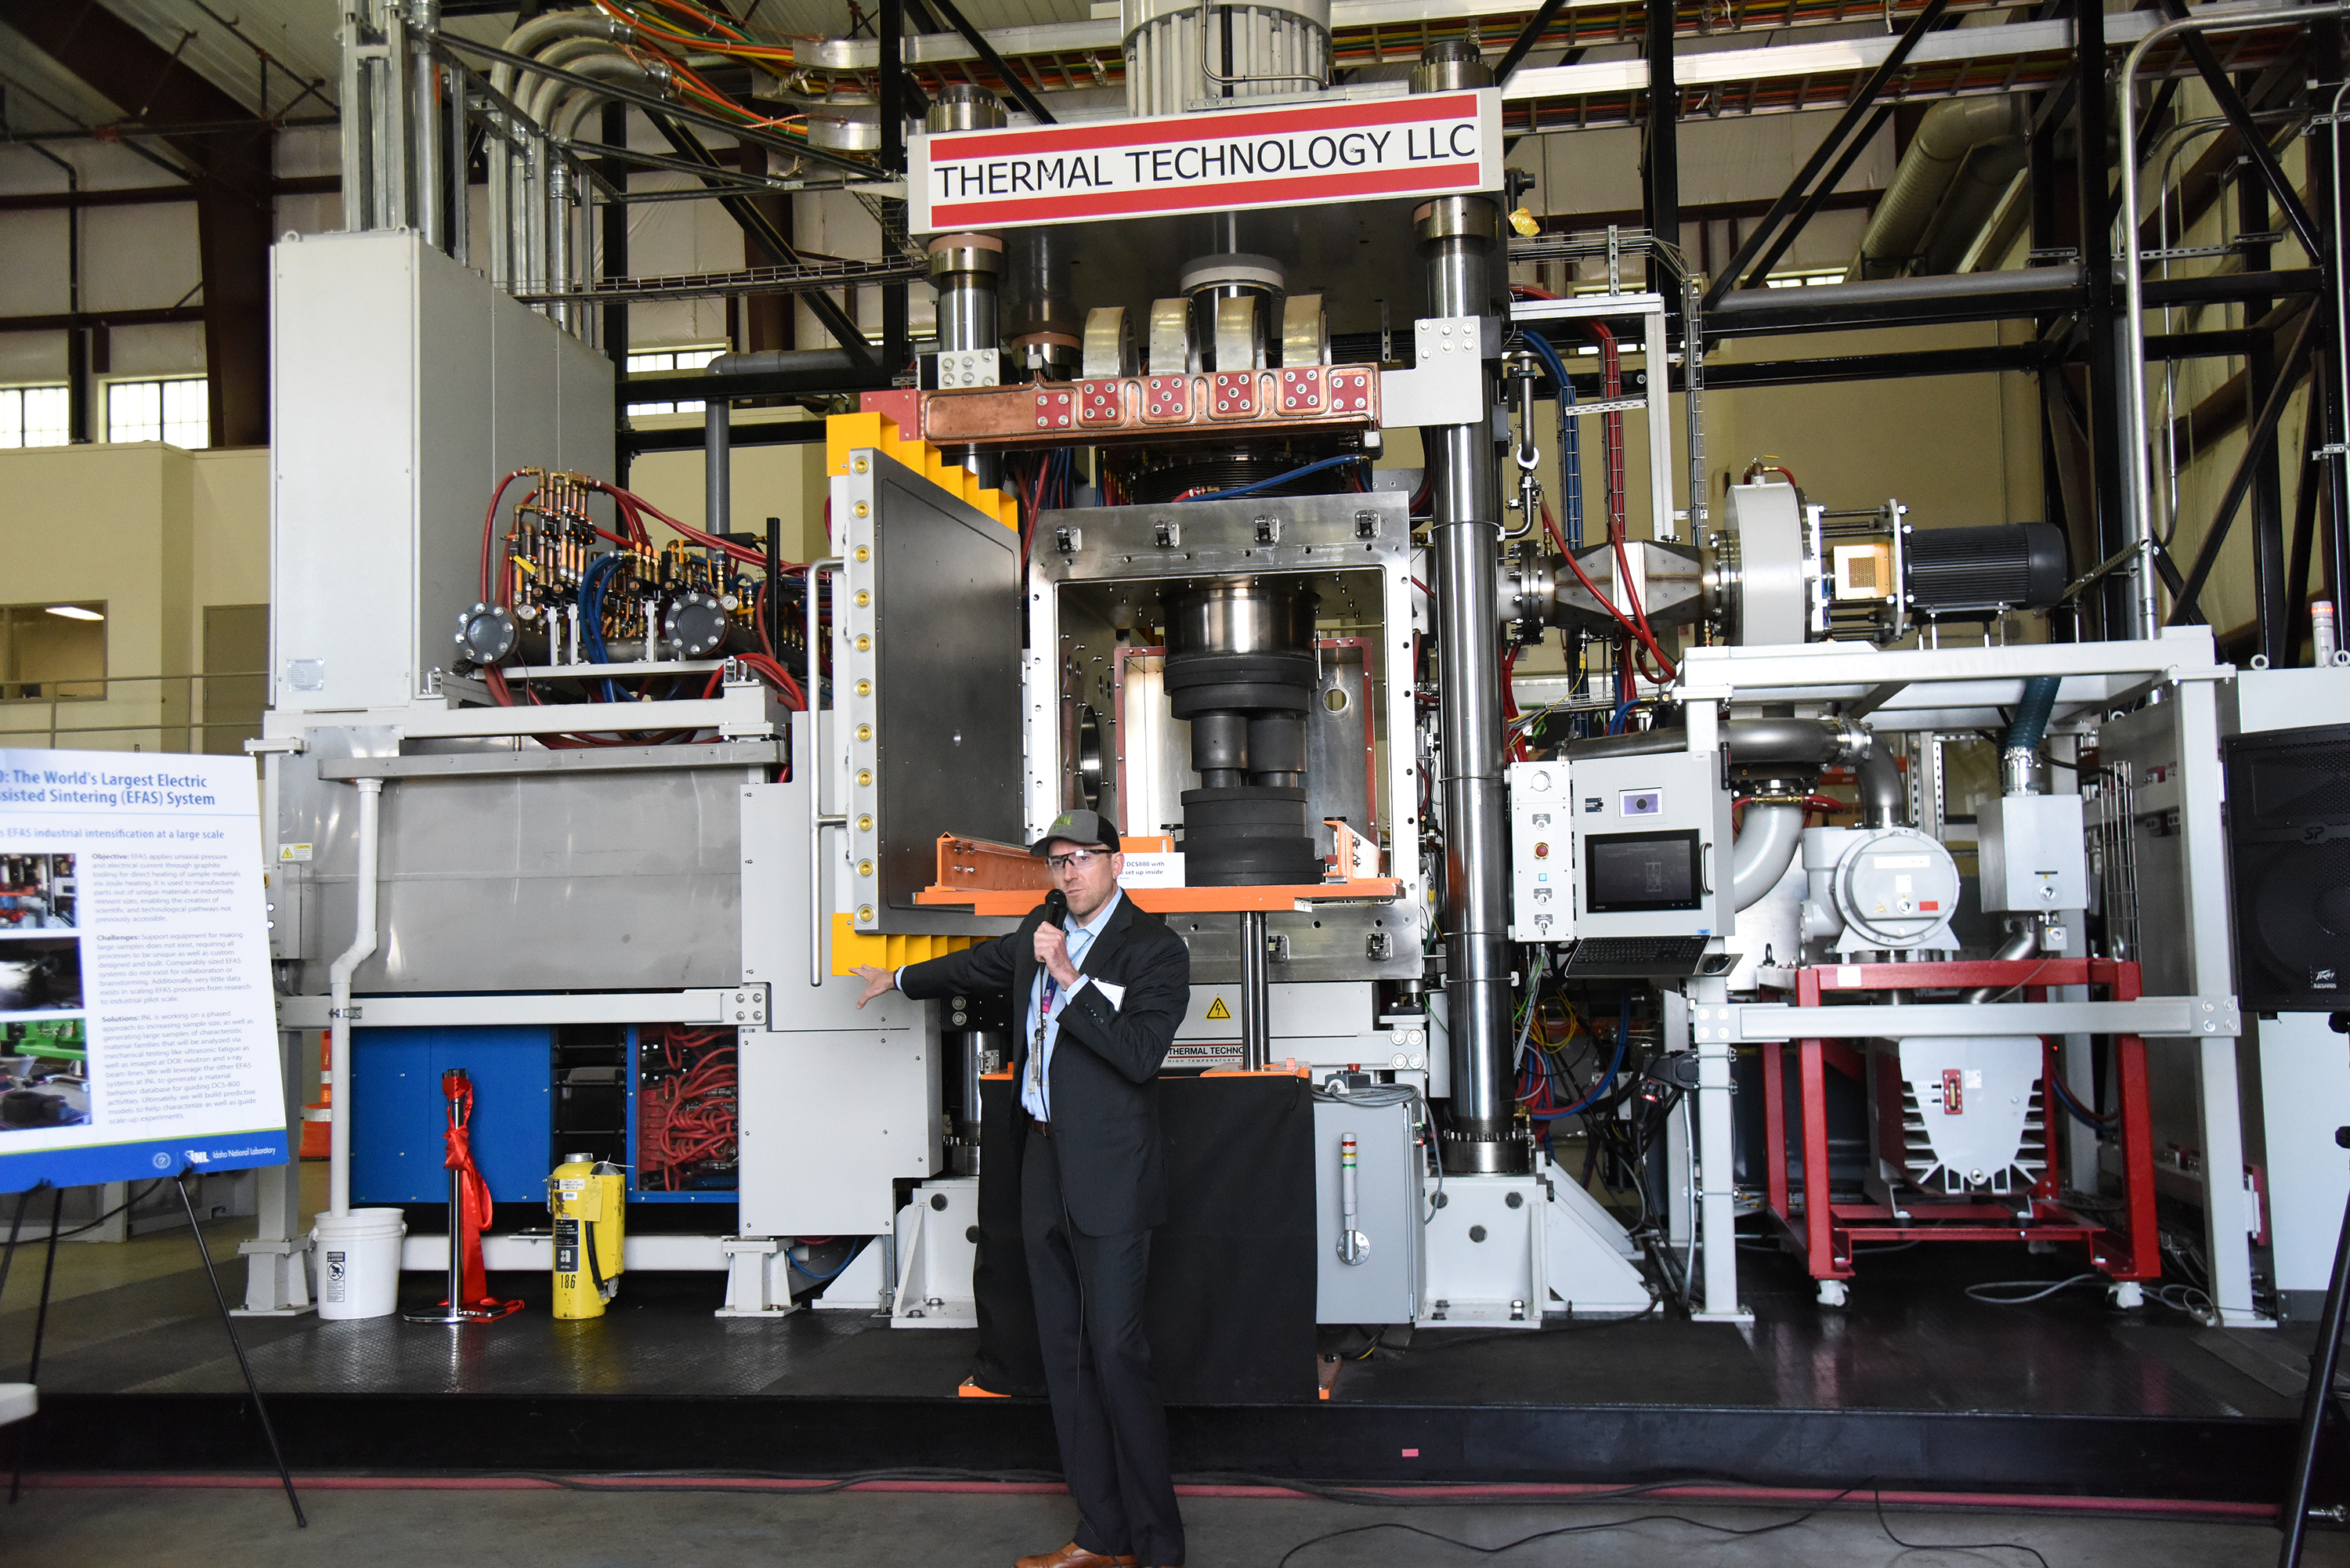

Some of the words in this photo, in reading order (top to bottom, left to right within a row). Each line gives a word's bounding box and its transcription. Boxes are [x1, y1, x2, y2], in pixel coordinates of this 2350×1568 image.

[934, 155, 1112, 197] THERMAL
[1125, 131, 1391, 182] TECHNOLOGY
[1408, 124, 1475, 161] LLC
[13, 769, 40, 783] The
[44, 771, 97, 785] World's
[102, 772, 154, 789] Largest
[157, 774, 208, 787] Electric
[0, 788, 45, 801] sisted
[50, 789, 117, 807] Sintering
[121, 790, 164, 807] (EFAS)
[167, 792, 215, 807] System
[7, 828, 32, 837] EFAS
[34, 829, 83, 838] industrial
[85, 829, 154, 838] intensification
[177, 829, 201, 841] large
[203, 830, 225, 839] scale
[96, 934, 140, 942] Challenges:
[98, 961, 131, 970] designed
[166, 959, 207, 967] Comparably
[130, 987, 154, 995] scaling
[102, 1014, 140, 1023] Solutions:
[161, 1012, 189, 1021] working
[207, 1010, 231, 1019] phased
[103, 1024, 136, 1034] approach
[146, 1021, 181, 1031] increasing
[183, 1021, 207, 1029] sample
[103, 1033, 141, 1042] generating
[143, 1031, 161, 1040] large
[162, 1030, 190, 1039] samples
[200, 1027, 243, 1035] characteristic
[201, 1037, 230, 1046] analyzed
[104, 1051, 144, 1060] mechanical
[146, 1050, 169, 1058] testing
[184, 1046, 216, 1055] ultrasonic
[218, 1045, 241, 1054] fatigue
[130, 1059, 157, 1068] imaged
[173, 1065, 202, 1075] leverage
[107, 1080, 135, 1089] systems
[167, 1075, 197, 1085] generate
[204, 1072, 231, 1081] material
[107, 1088, 138, 1097] behavior
[139, 1086, 172, 1094] database
[183, 1082, 210, 1093] guiding
[107, 1097, 141, 1106] activities.
[142, 1094, 179, 1104] Ultimately,
[223, 1089, 256, 1099] predictive
[146, 1104, 161, 1114] help
[163, 1101, 204, 1111] characterize
[237, 1097, 256, 1107] guide
[109, 1115, 139, 1125] scale-up
[140, 1112, 186, 1123] experiments.
[190, 1151, 210, 1163] INL
[250, 1147, 277, 1155] Laboratory
[561, 1274, 576, 1288] 186
